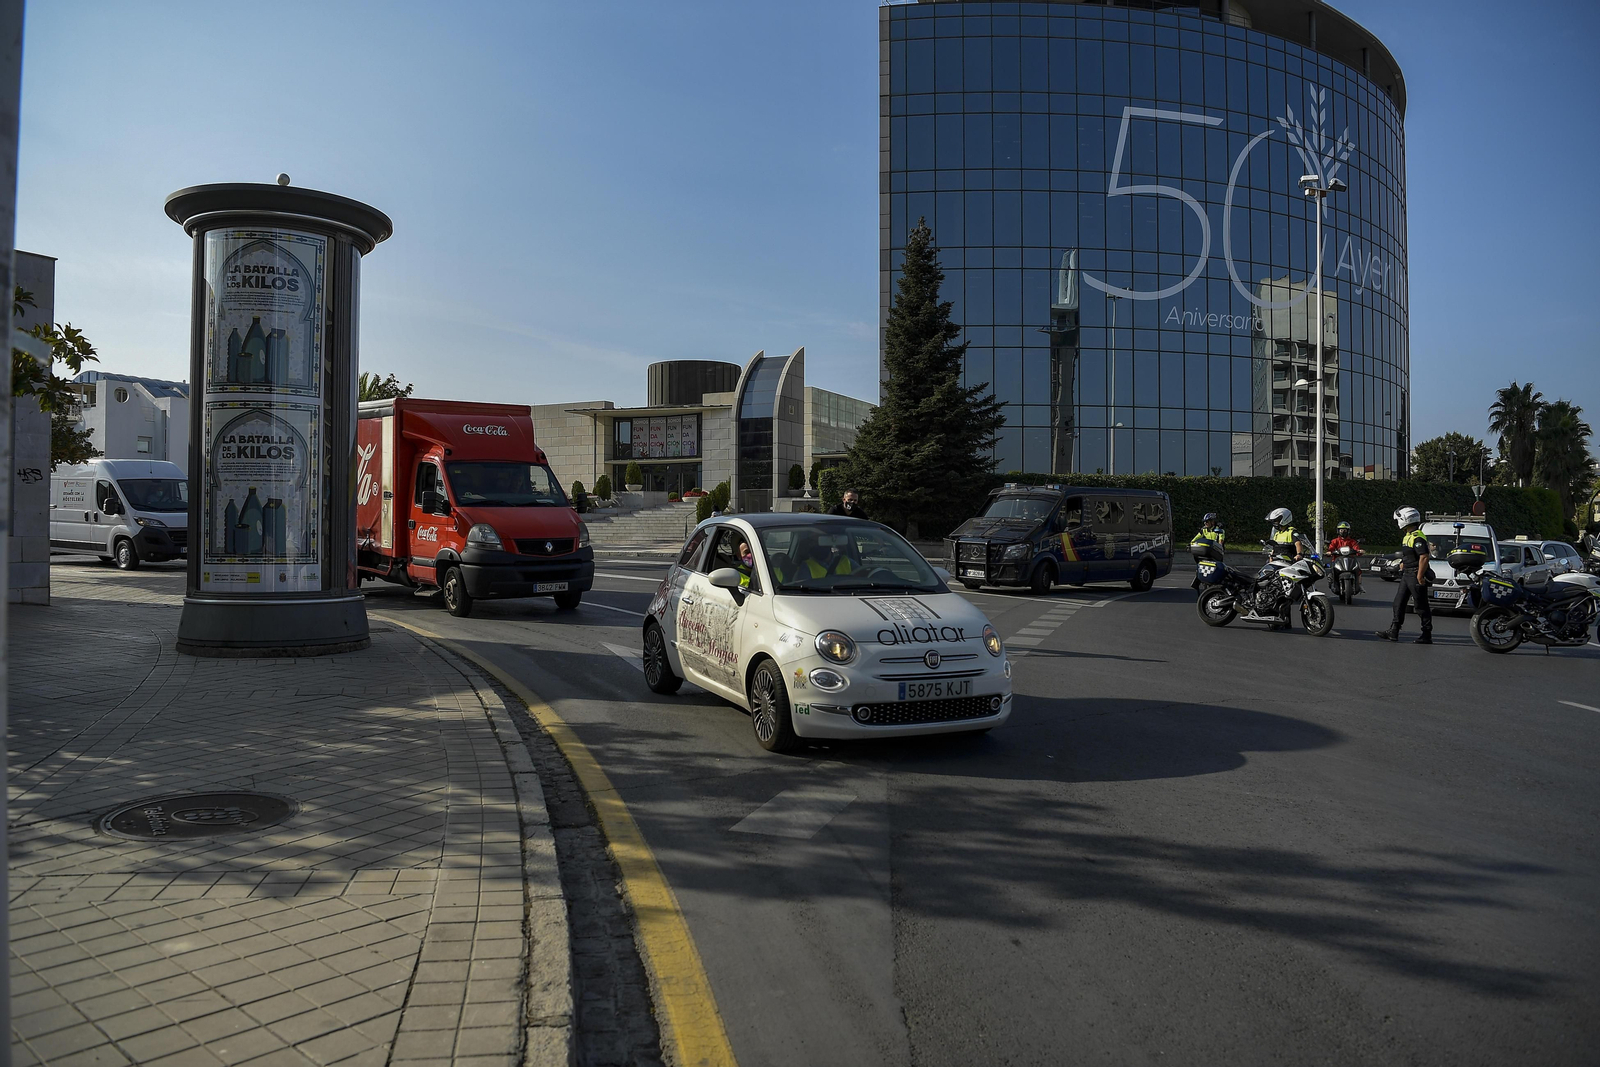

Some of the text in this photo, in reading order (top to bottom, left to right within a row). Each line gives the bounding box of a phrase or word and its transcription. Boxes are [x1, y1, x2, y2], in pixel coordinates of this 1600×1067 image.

[1082, 106, 1328, 310] 50
[229, 265, 299, 277] LA BATALLA
[242, 275, 299, 292] KILOS
[1165, 306, 1265, 331] Aniversario
[222, 435, 294, 445] LA BATALLA
[237, 445, 295, 460] KILOS
[877, 622, 966, 646] aliatar
[908, 681, 970, 698] 5875 KJT
[794, 703, 810, 715] Ted
